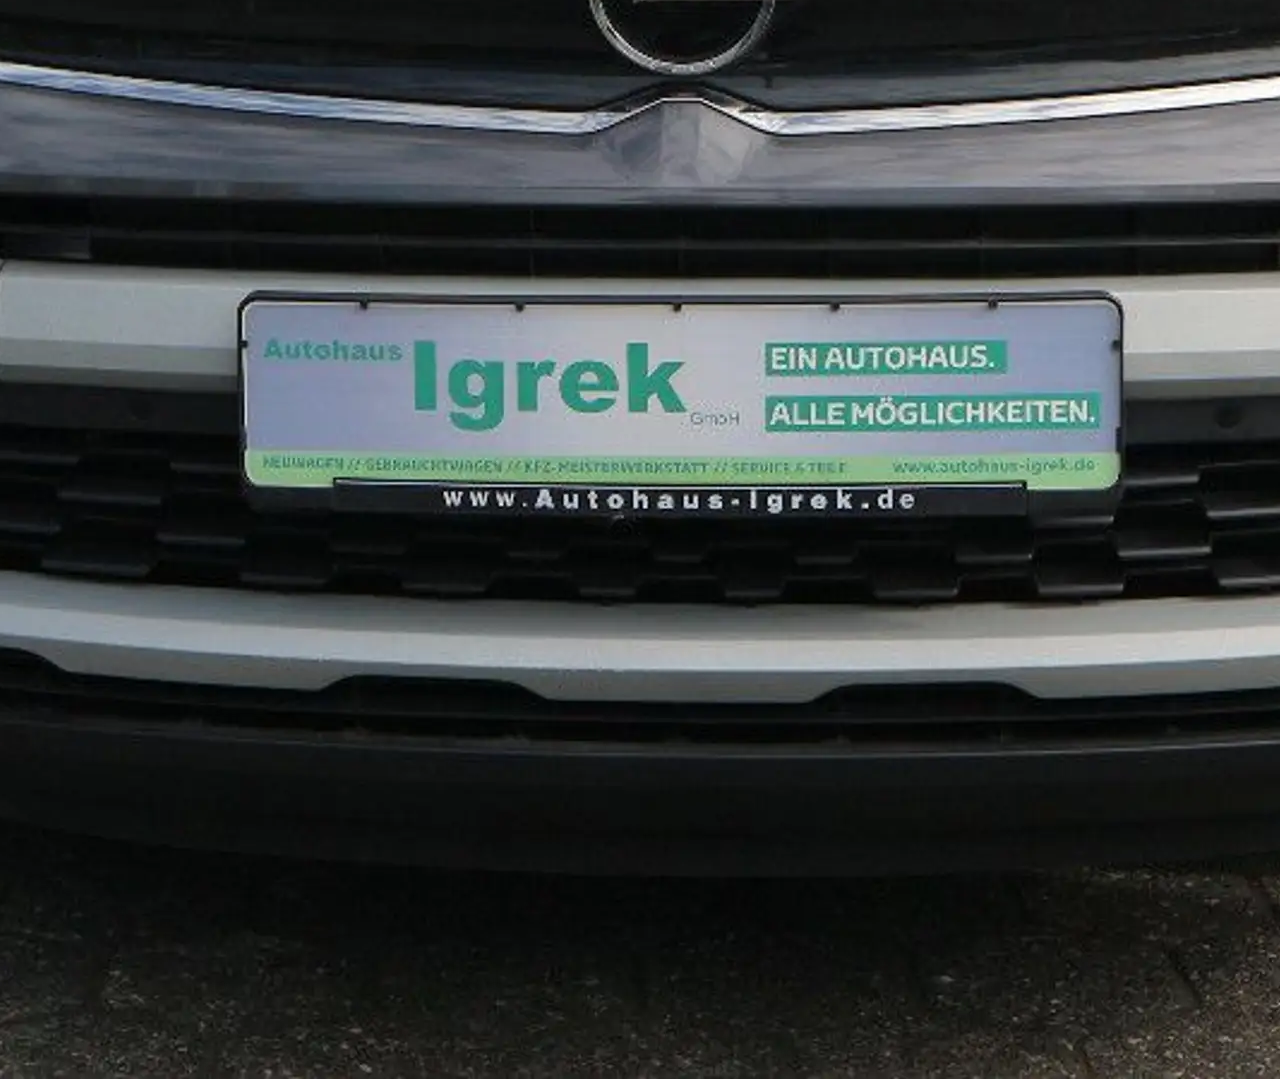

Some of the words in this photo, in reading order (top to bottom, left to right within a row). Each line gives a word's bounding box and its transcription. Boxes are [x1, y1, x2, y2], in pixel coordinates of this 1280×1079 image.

[771, 346, 817, 370] EIN
[823, 344, 995, 370] AUTOHAUS.
[263, 338, 404, 362] Autohaus
[413, 339, 687, 432] Igrek
[689, 411, 741, 426] GmbH
[769, 401, 846, 426] ALLE
[851, 396, 1096, 425] MÖGLICHKEITEN.
[892, 457, 1096, 476] www.autohaus-igrek.de
[442, 488, 917, 514] www.Autohaus-Igrek.de
